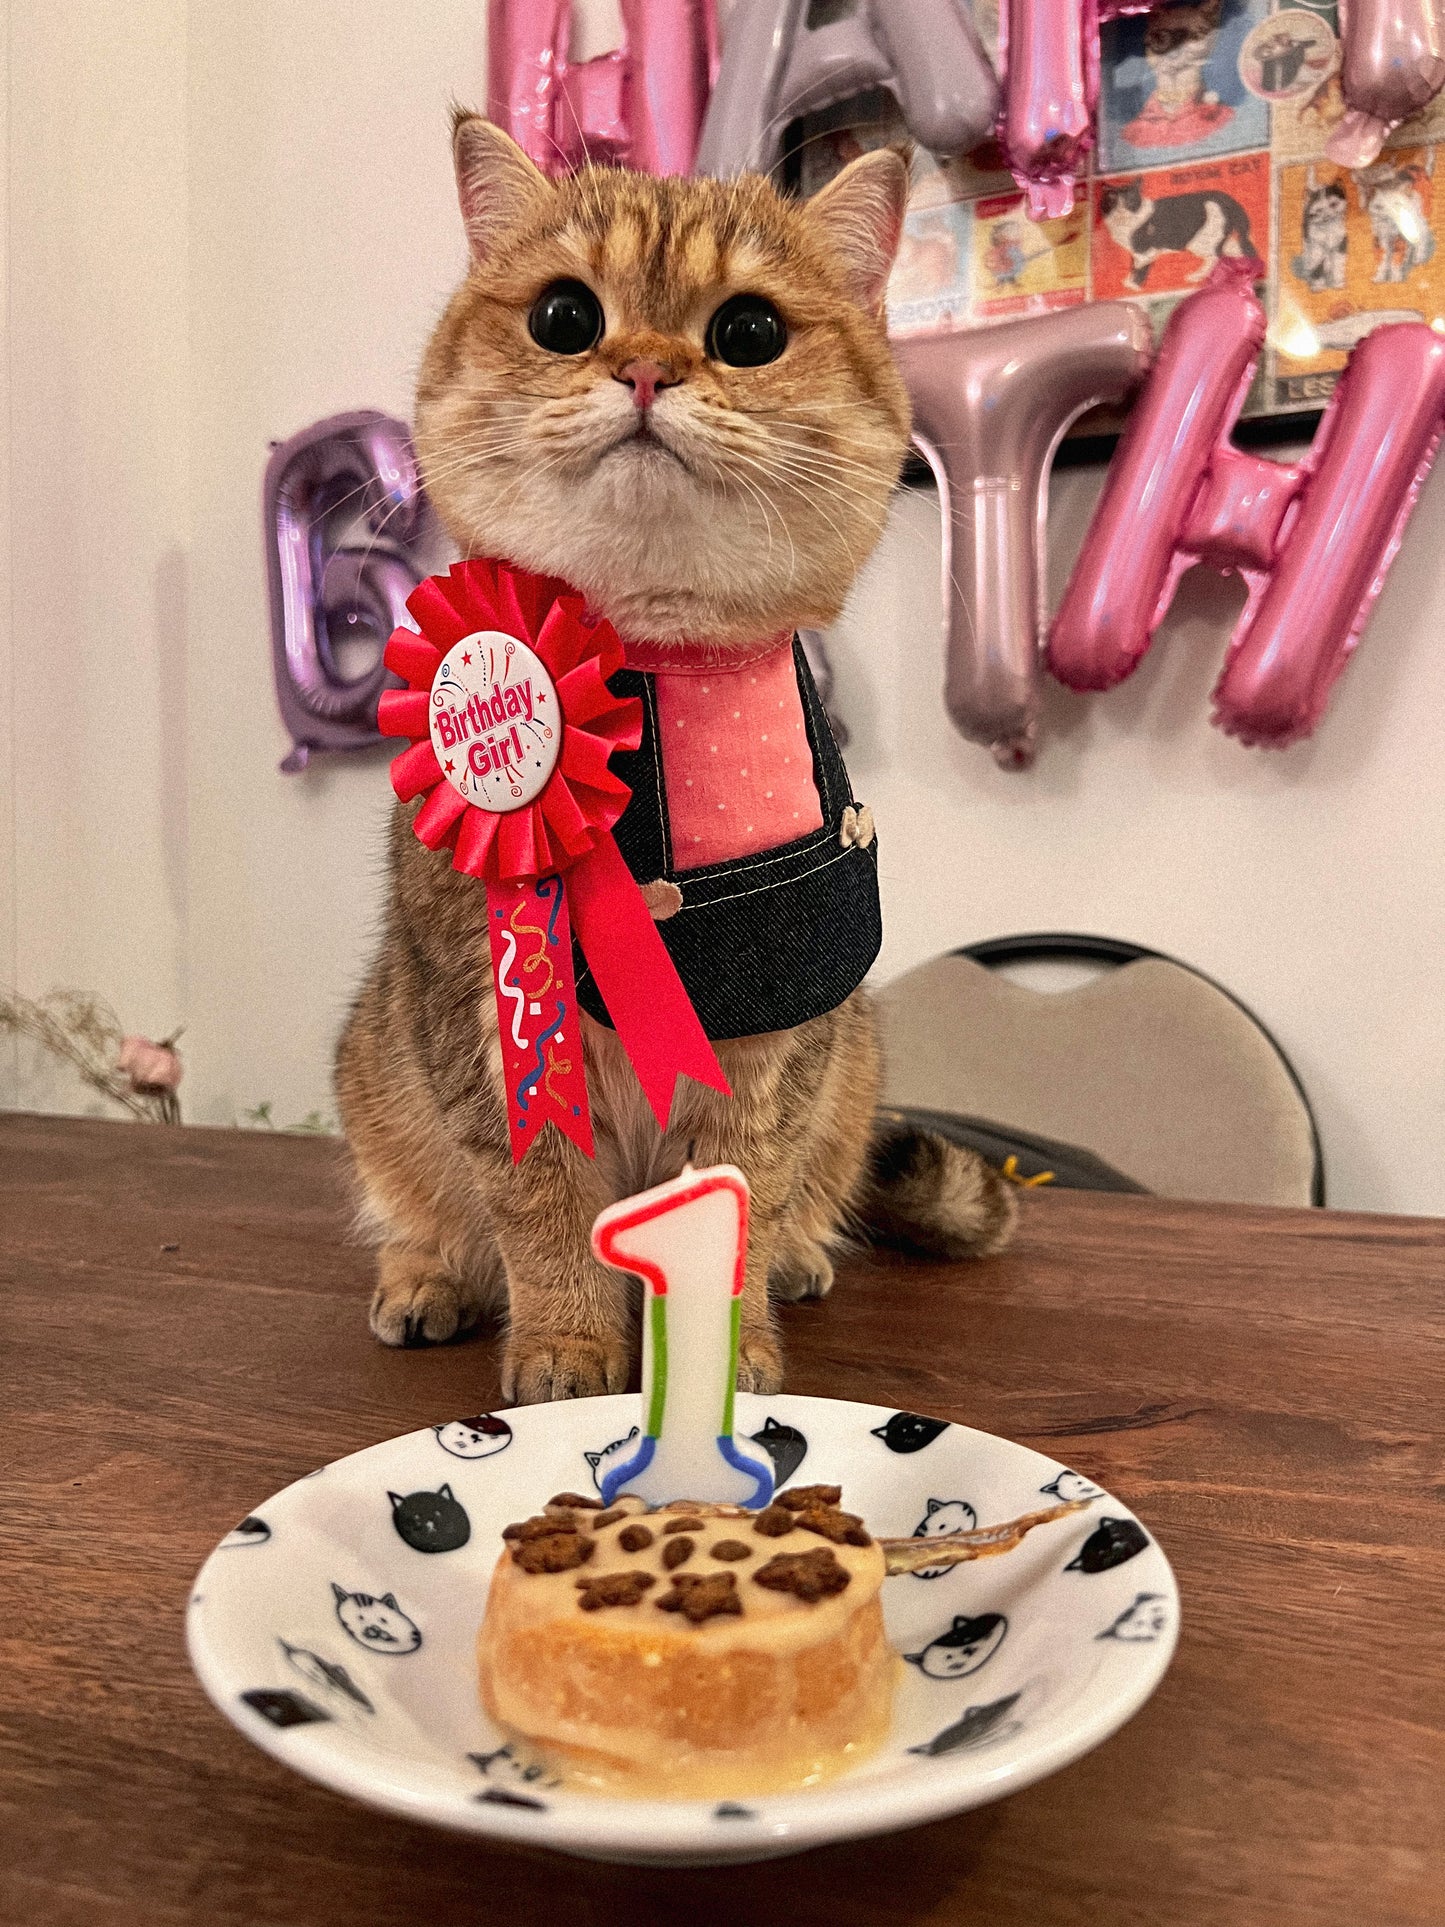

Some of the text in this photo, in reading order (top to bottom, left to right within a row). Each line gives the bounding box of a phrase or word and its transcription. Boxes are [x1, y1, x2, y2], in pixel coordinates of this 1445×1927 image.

[436, 679, 533, 750] Birthday
[468, 725, 525, 777] Girl
[591, 1165, 775, 1509] 1
